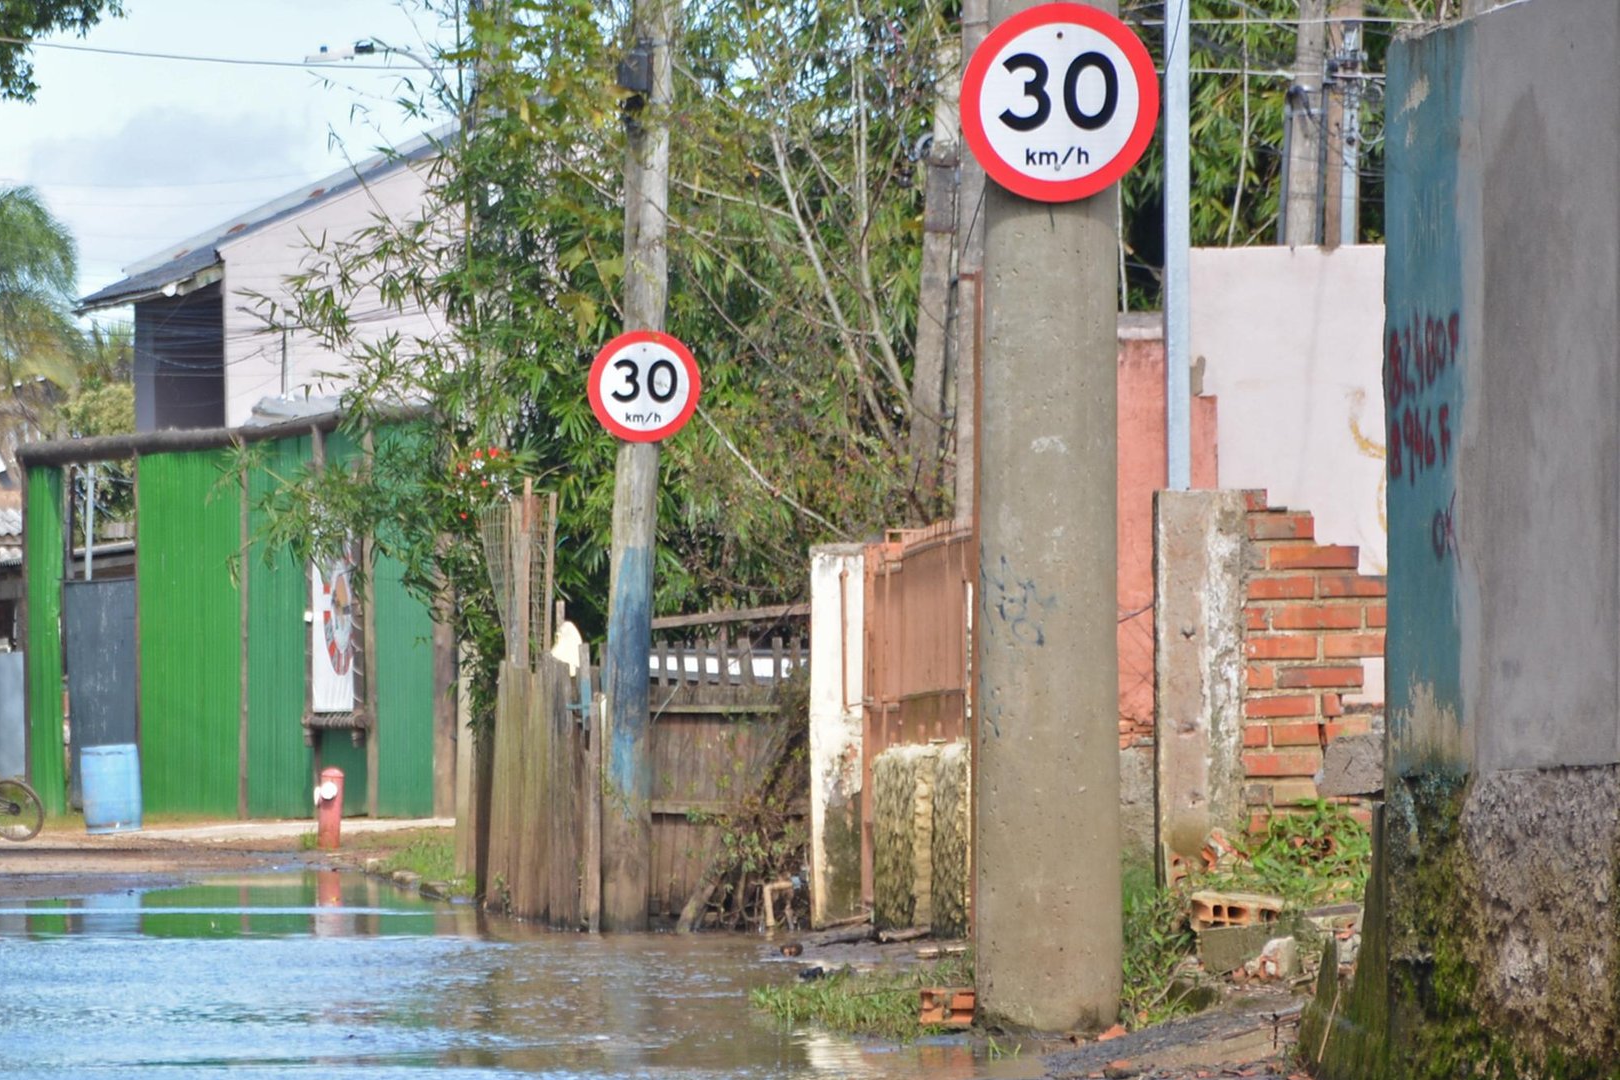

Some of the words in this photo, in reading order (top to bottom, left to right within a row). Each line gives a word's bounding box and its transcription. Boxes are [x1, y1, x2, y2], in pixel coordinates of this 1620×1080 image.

[999, 51, 1118, 131] 30
[1025, 146, 1089, 166] km/h
[611, 359, 678, 403] 30
[625, 412, 662, 423] km/h
